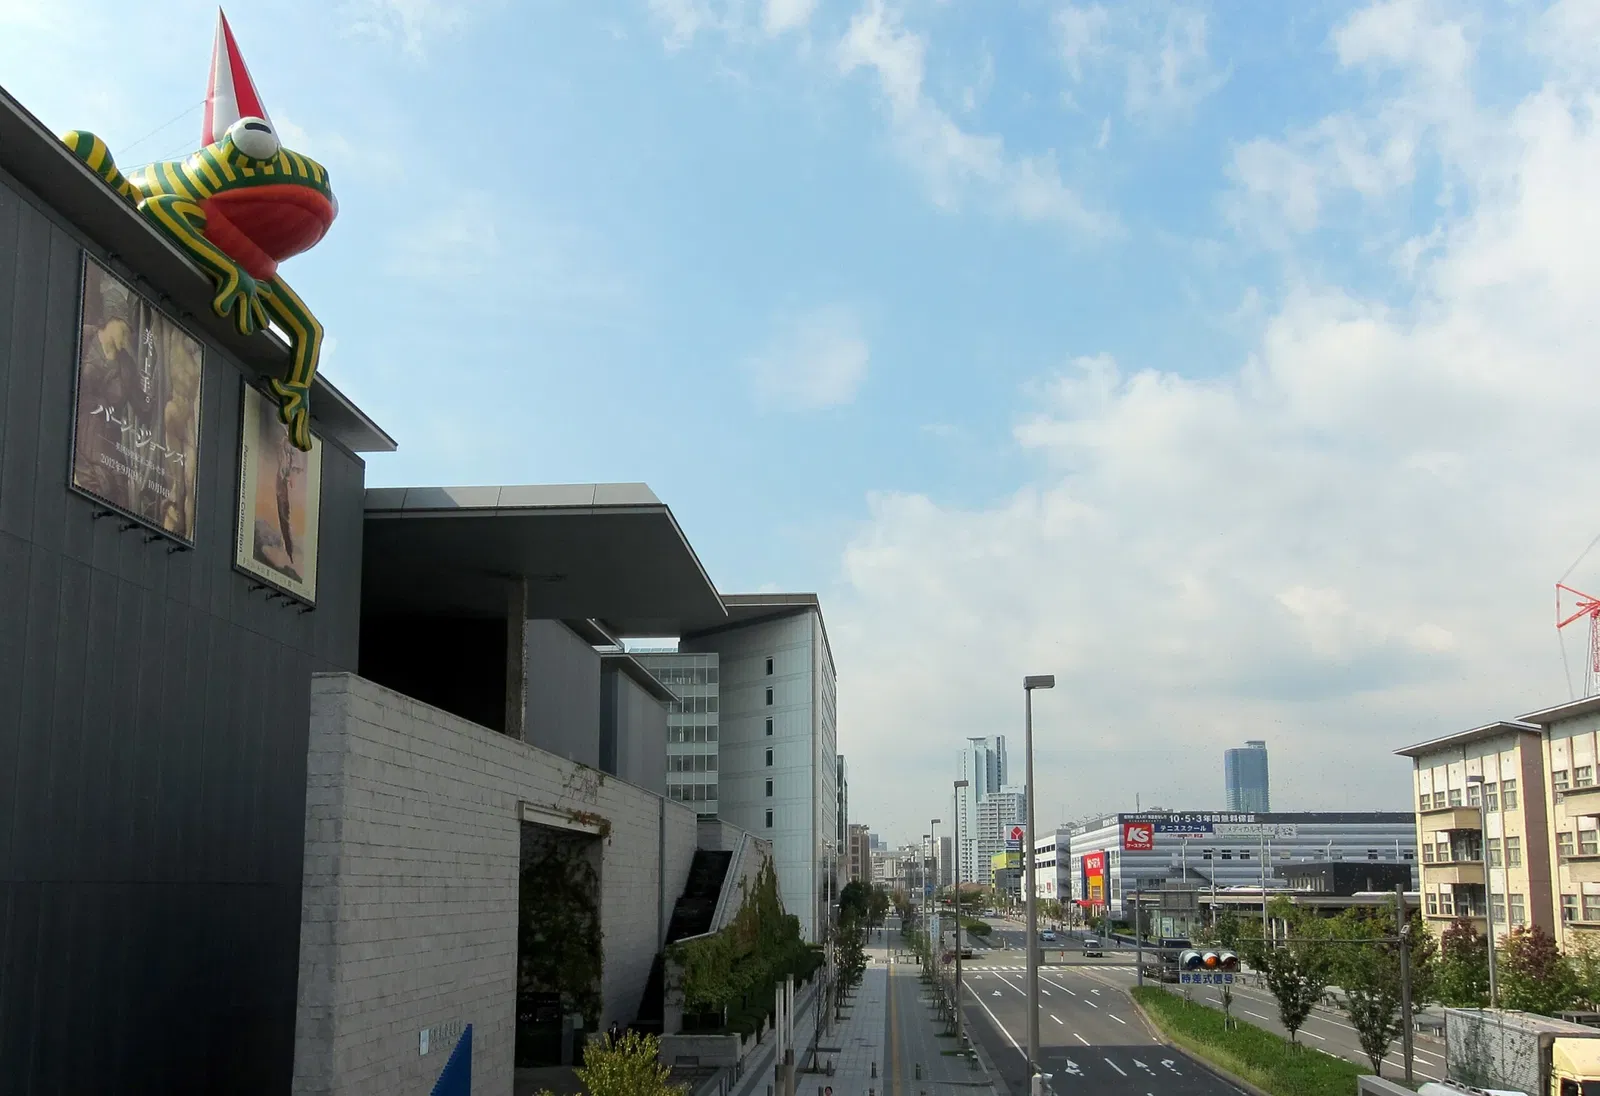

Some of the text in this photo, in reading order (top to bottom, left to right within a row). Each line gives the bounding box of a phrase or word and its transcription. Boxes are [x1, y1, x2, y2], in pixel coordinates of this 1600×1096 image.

[238, 443, 250, 553] Permanent Collection
[1181, 973, 1234, 985] 時差式信号
